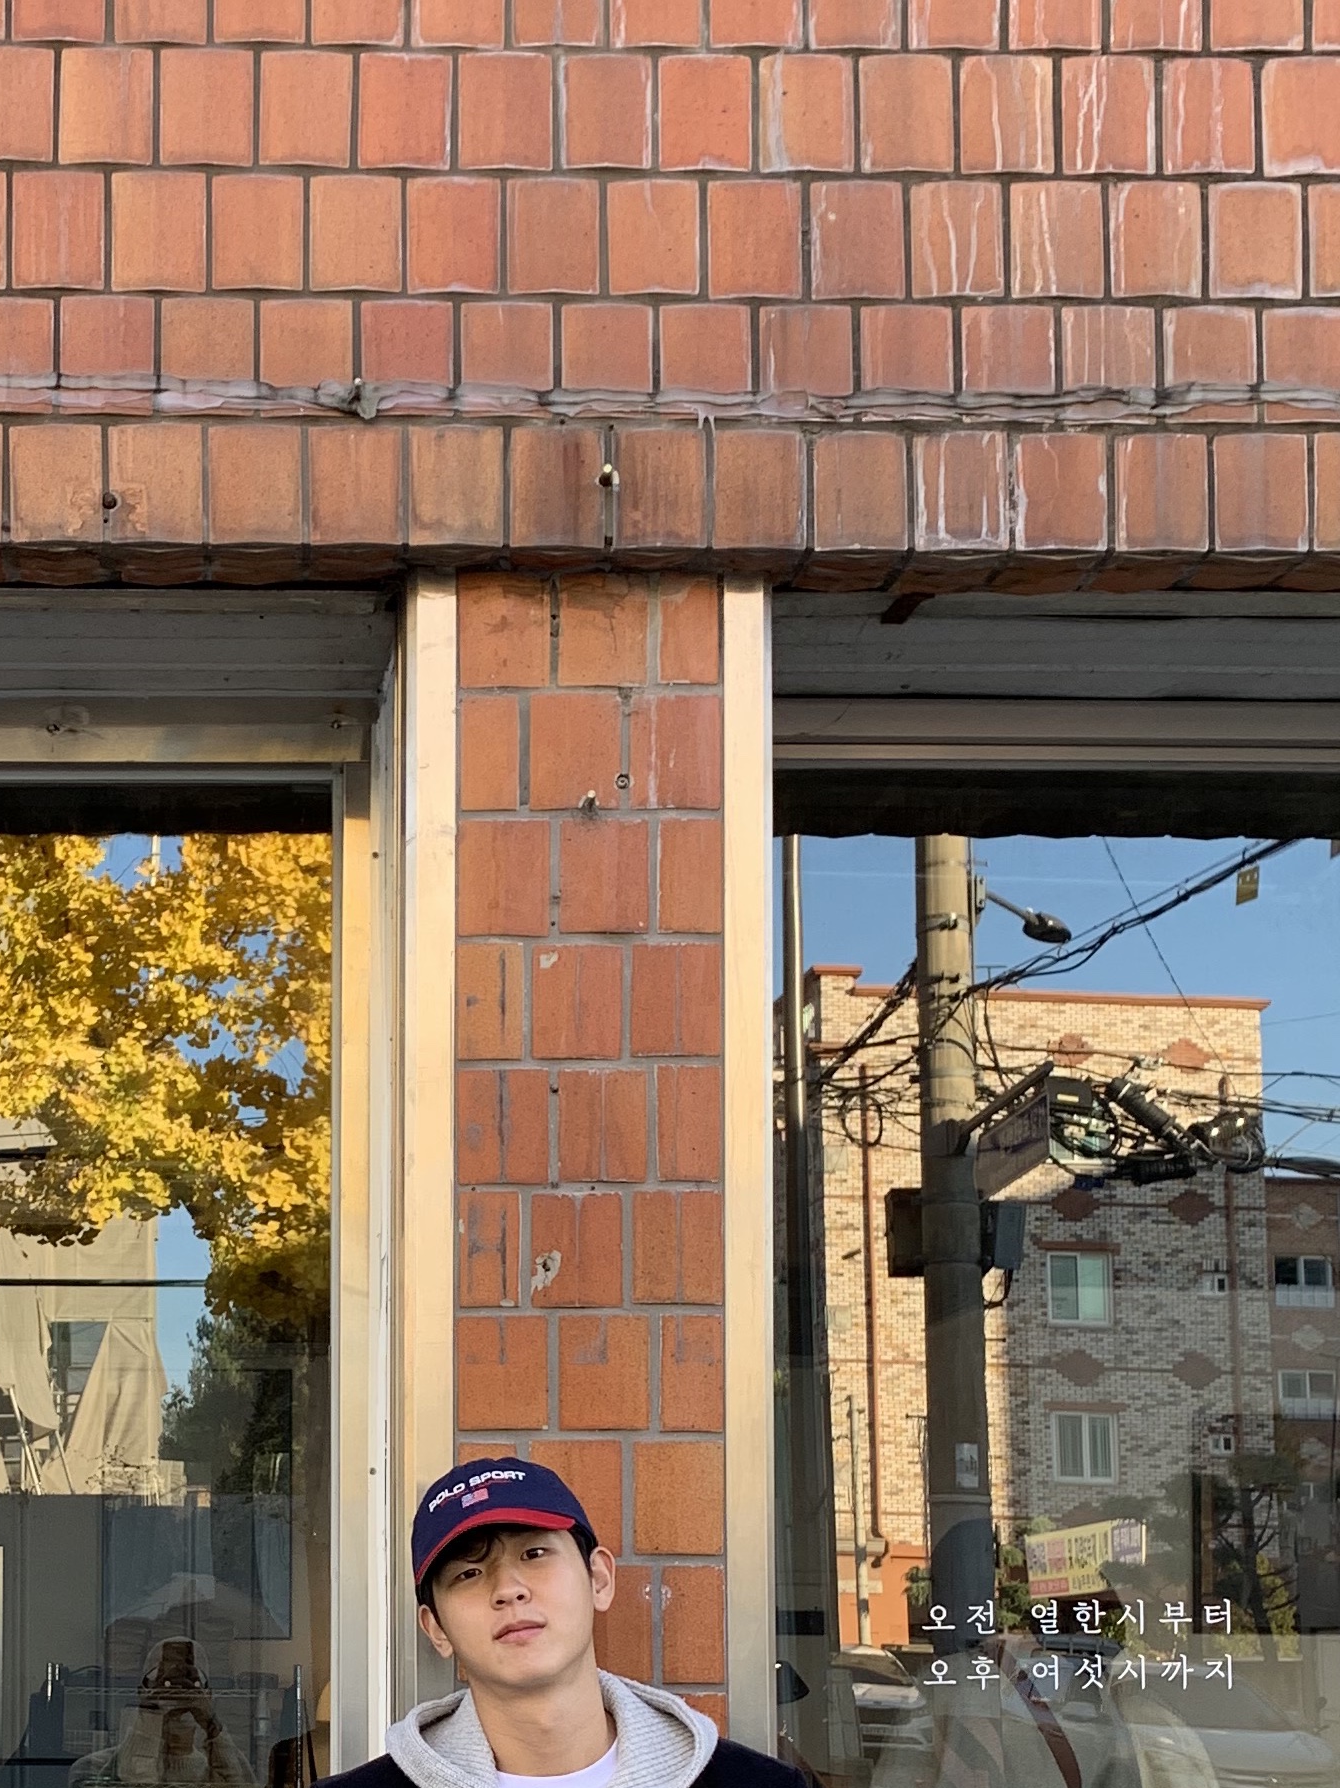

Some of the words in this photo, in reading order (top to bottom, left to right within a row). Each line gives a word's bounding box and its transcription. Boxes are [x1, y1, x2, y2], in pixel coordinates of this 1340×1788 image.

[427, 1482, 466, 1513] POLO
[468, 1470, 526, 1487] SPORT
[921, 1599, 997, 1635] 오전
[1030, 1598, 1232, 1635] 열한시부터
[923, 1655, 1000, 1690] 오후
[1031, 1653, 1233, 1691] 여섯시까지
